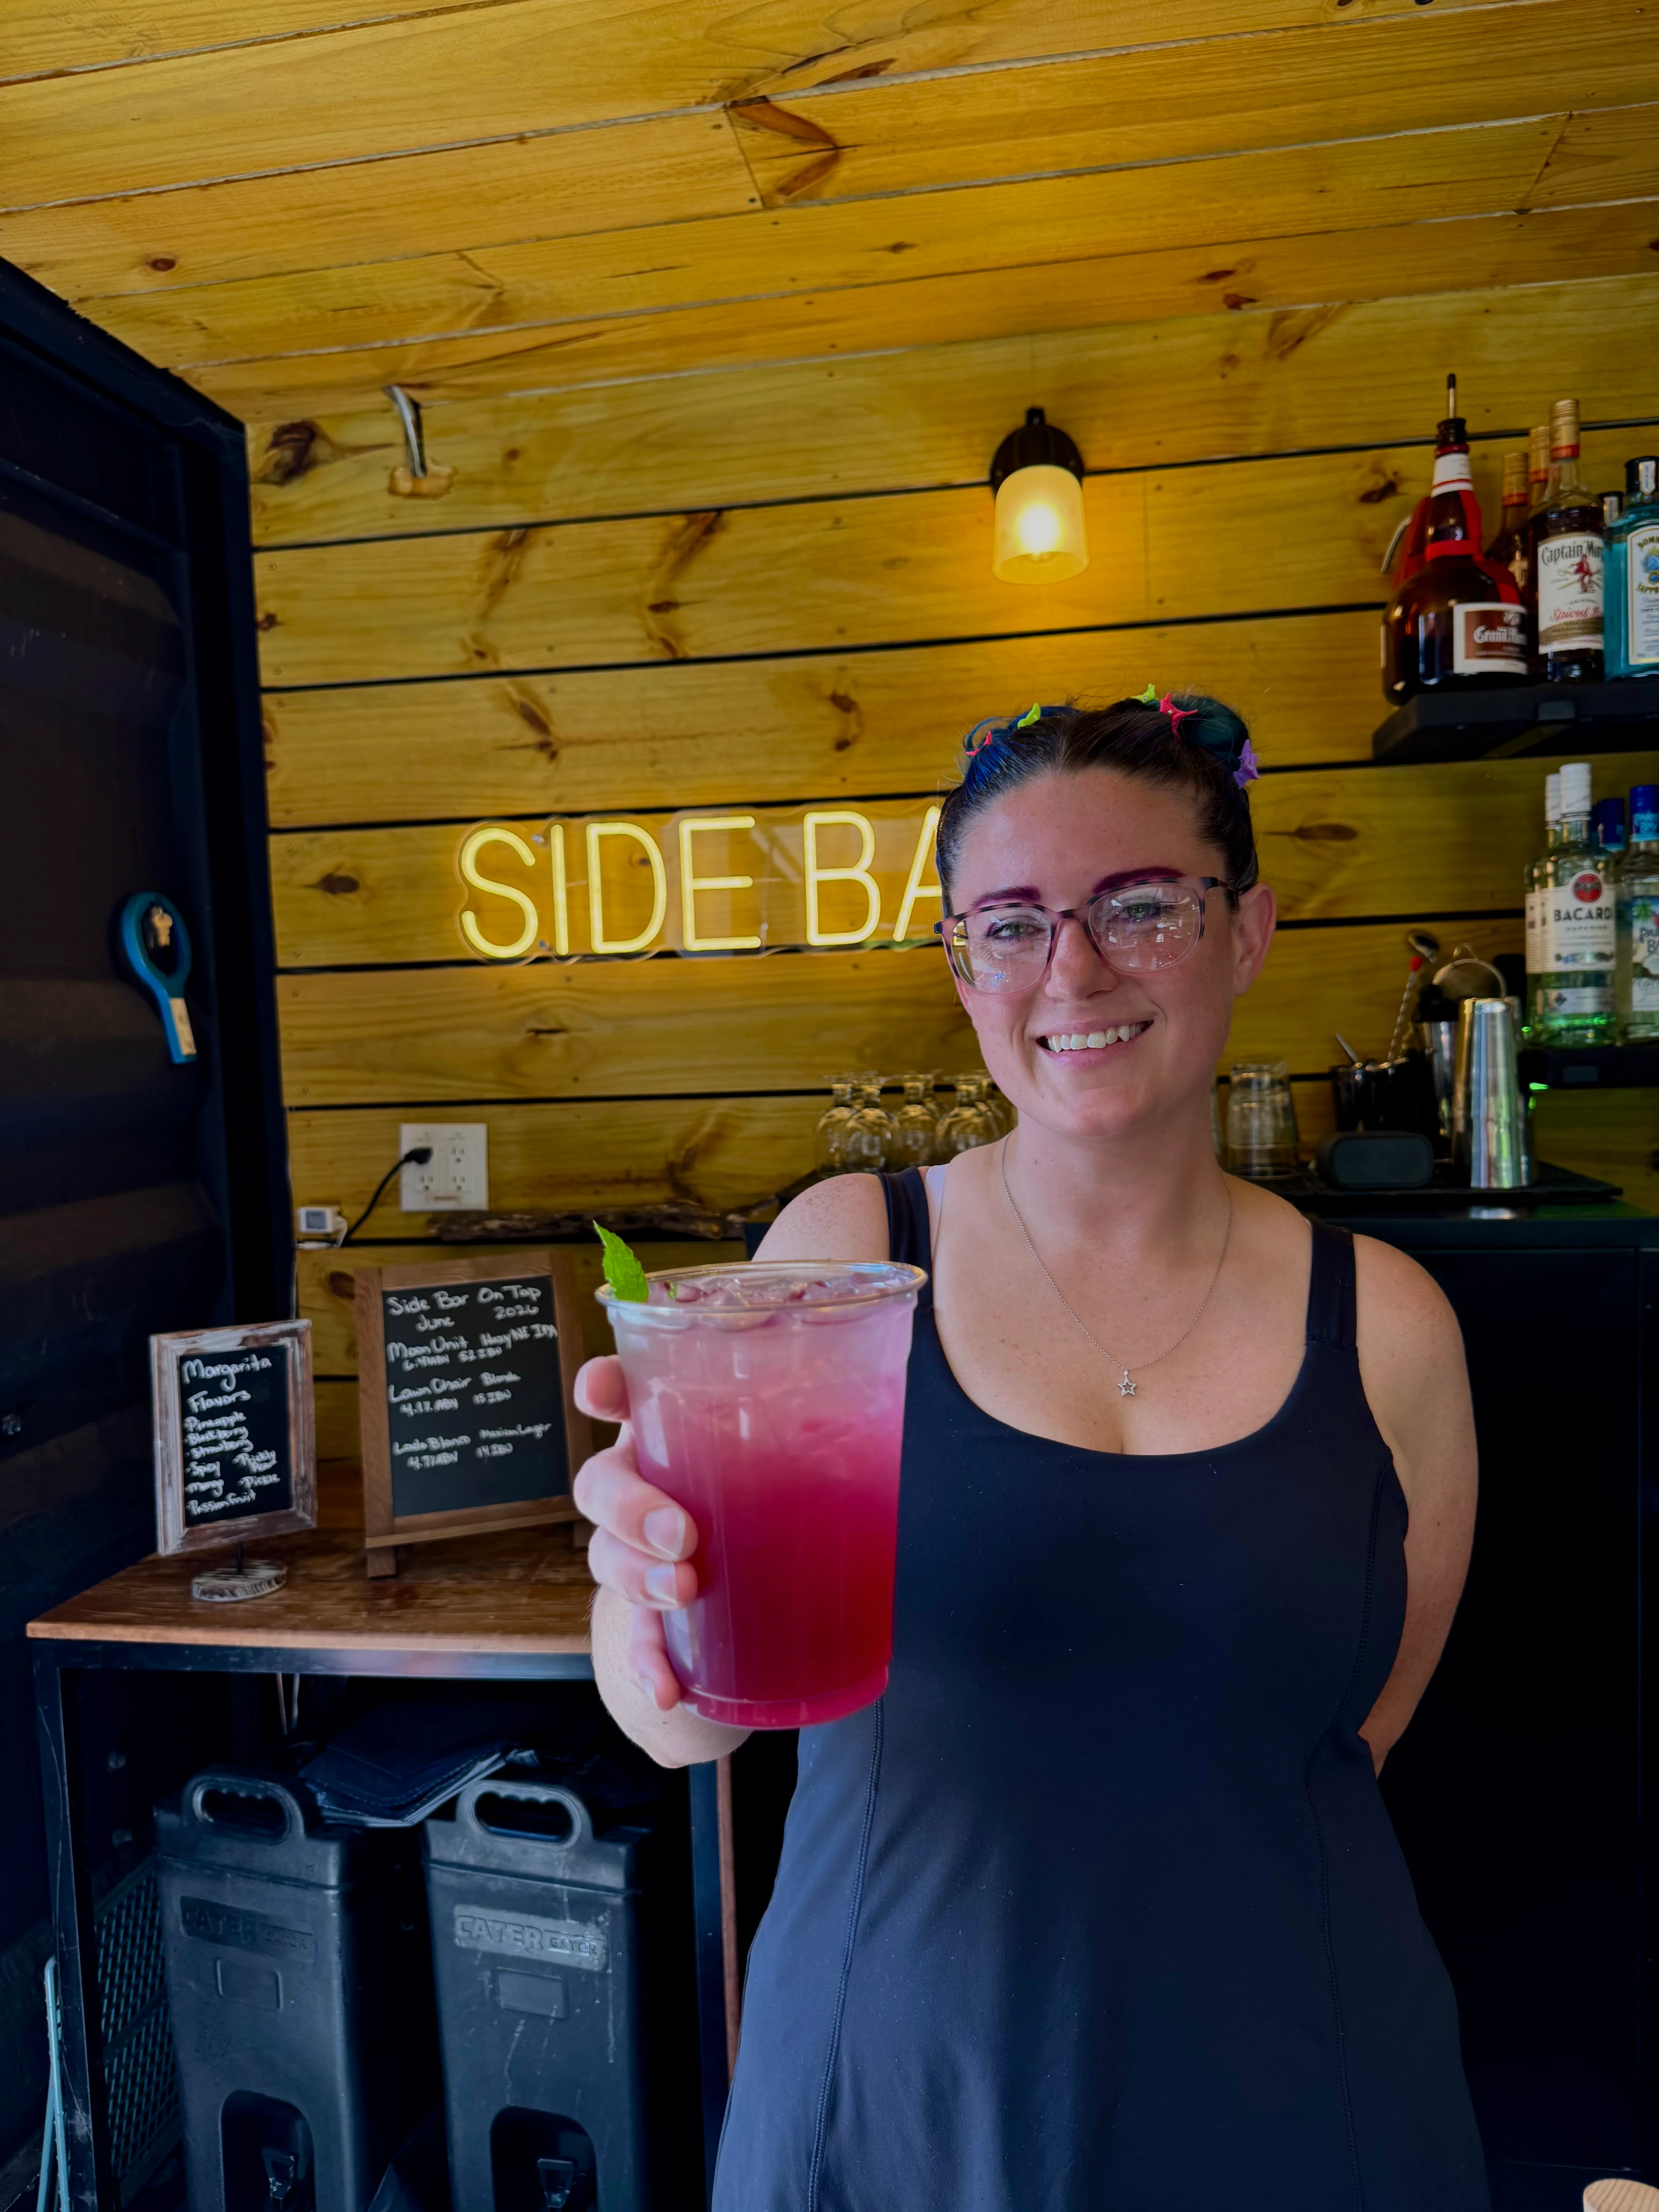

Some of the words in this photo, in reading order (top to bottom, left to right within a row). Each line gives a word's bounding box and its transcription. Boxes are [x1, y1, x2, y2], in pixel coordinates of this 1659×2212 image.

[1541, 542, 1583, 567] Captain
[461, 814, 762, 959] SIDE
[804, 805, 942, 946] BA
[1554, 907, 1611, 922] BACARD
[387, 1296, 431, 1316] Side
[431, 1291, 469, 1310] Bar
[477, 1287, 504, 1304] On
[416, 1314, 455, 1332] June
[430, 1336, 469, 1354] Unit
[181, 1354, 272, 1393] Margarita
[430, 1377, 472, 1395] Chair
[186, 1390, 251, 1413] Flavors
